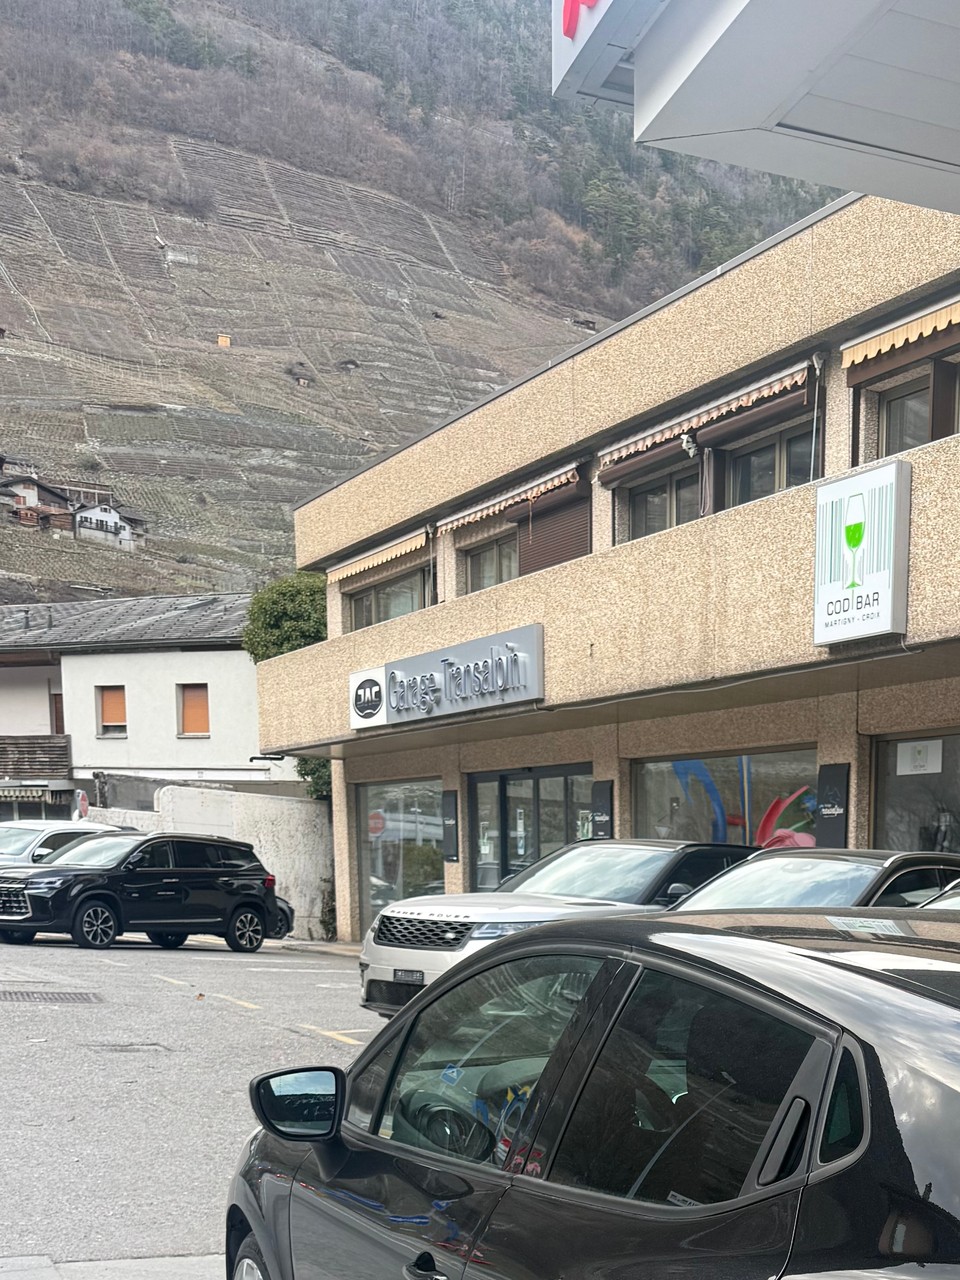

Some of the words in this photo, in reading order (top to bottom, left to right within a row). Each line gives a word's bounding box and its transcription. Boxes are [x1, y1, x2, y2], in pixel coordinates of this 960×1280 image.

[824, 616, 855, 628] MARTIGNY
[862, 611, 880, 622] CROIX
[389, 670, 441, 714] Garage
[440, 642, 528, 701] Transalpin
[357, 685, 380, 704] JAC
